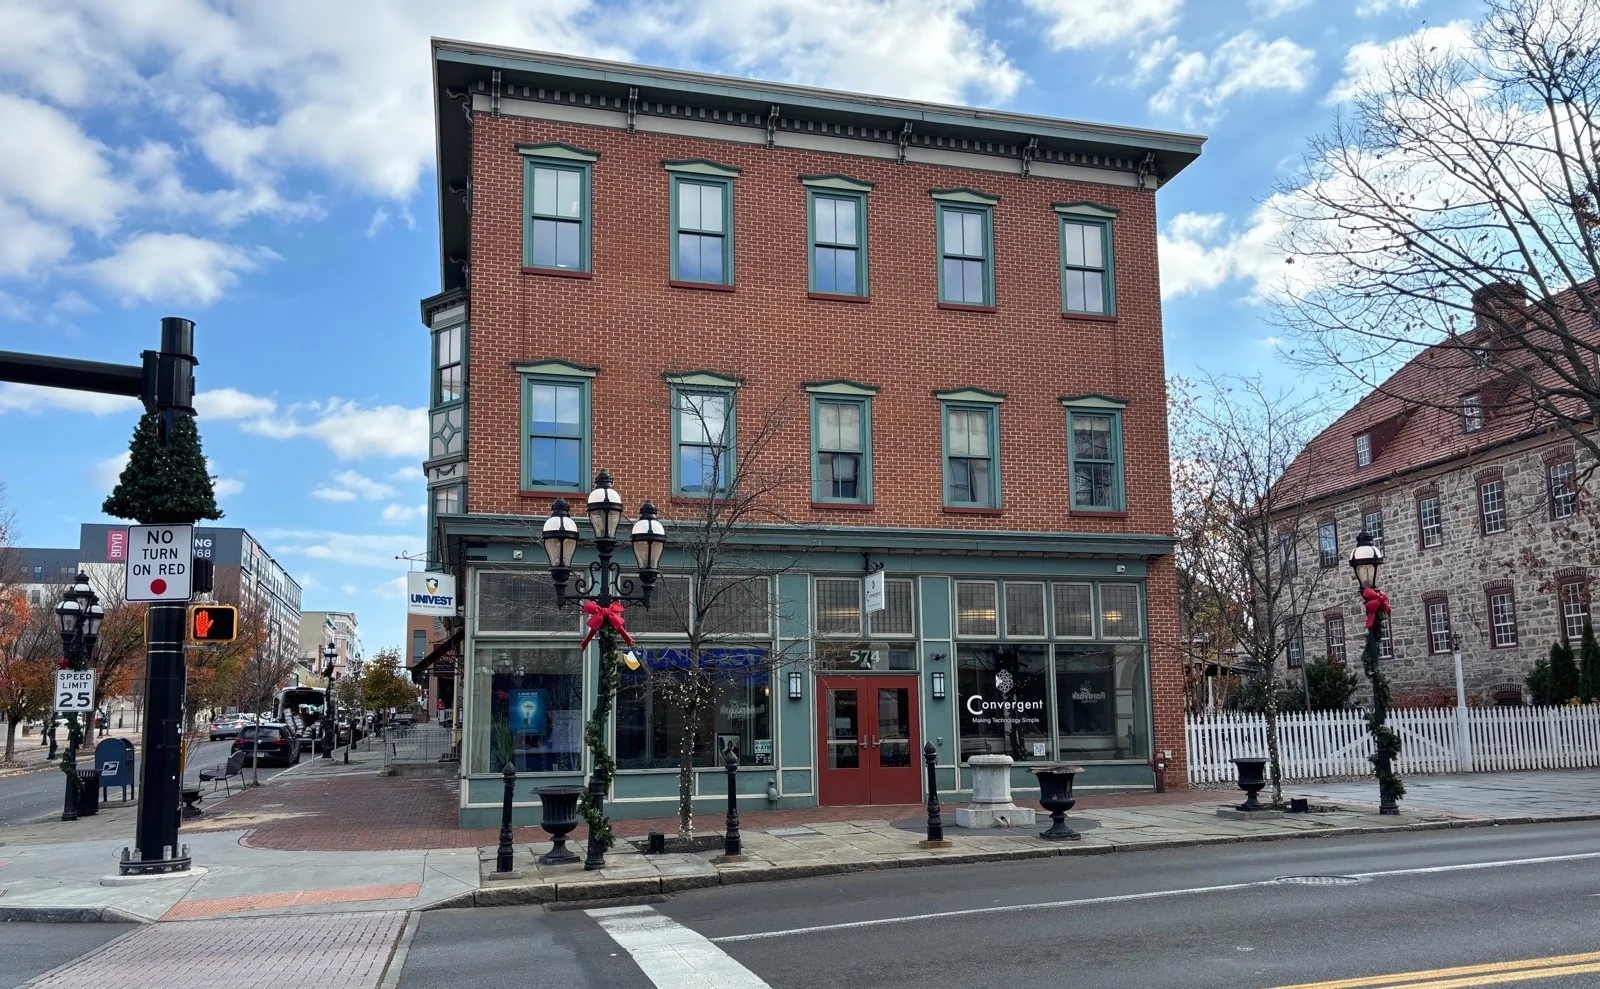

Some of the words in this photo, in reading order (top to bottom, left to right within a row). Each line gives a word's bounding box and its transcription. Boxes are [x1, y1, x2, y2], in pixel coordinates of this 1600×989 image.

[147, 530, 173, 544] NO
[111, 533, 123, 557] BOYD
[142, 548, 178, 560] TURN
[133, 564, 151, 576] ON
[159, 564, 185, 575] RED
[411, 594, 453, 605] UNIVEST
[850, 650, 880, 663] 574
[59, 692, 90, 707] 25
[967, 695, 1043, 715] Convergent
